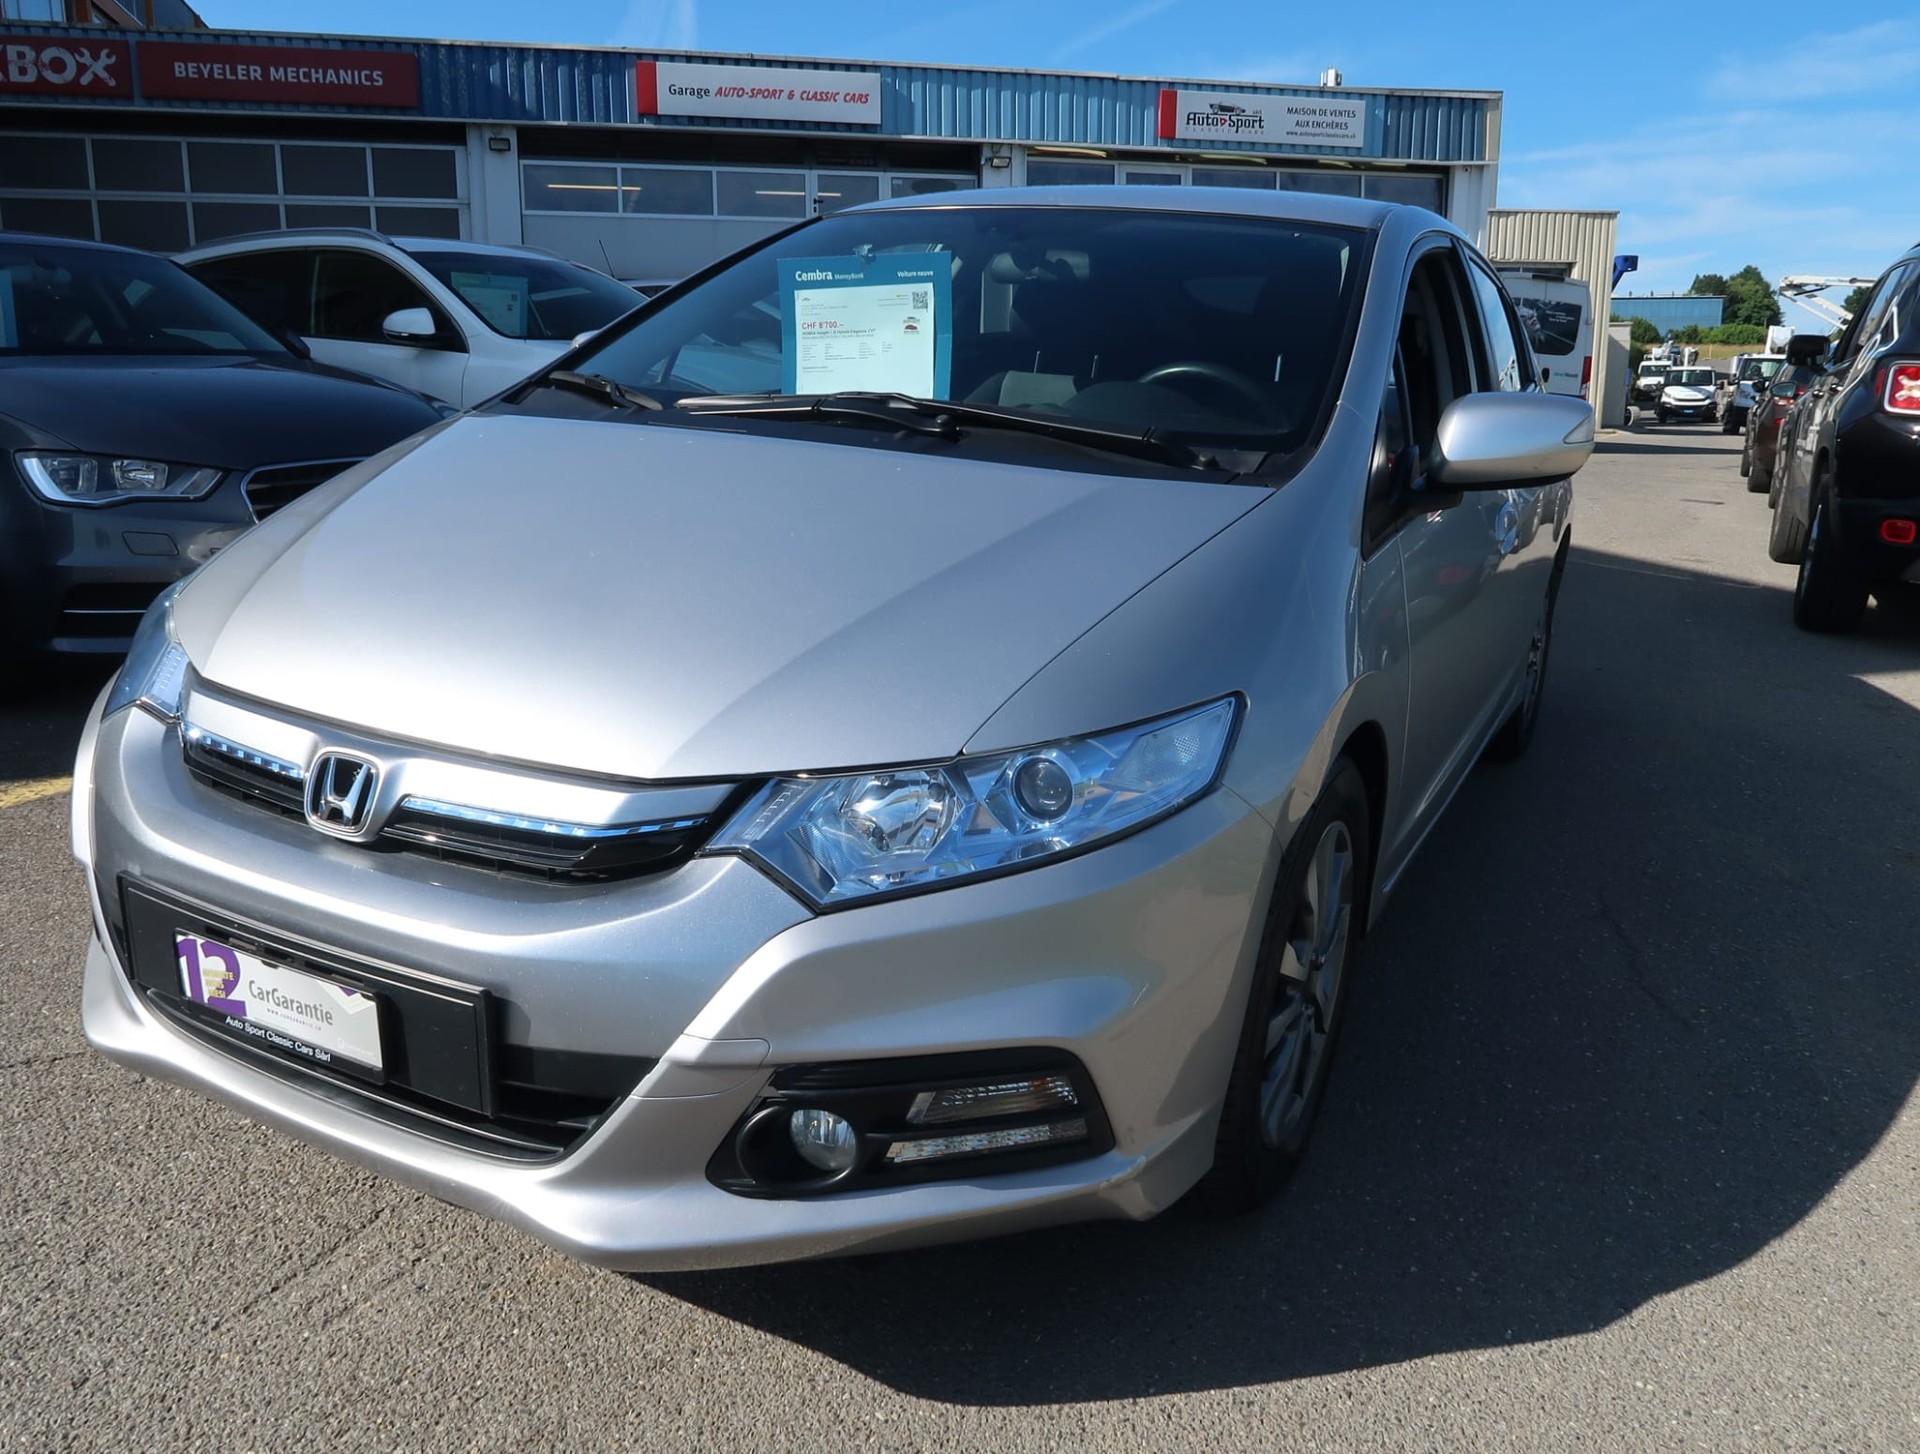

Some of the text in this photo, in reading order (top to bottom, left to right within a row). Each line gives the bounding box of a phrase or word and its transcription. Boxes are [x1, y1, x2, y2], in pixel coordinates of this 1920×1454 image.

[174, 61, 383, 86] BEYELER MECHANICS
[668, 84, 870, 104] Garage AUTO-SPORT & CLASSIC CARS
[1186, 111, 1264, 133] Auto Sport
[1286, 106, 1356, 119] MAISON DE VENTES
[1295, 119, 1349, 130] AUX ENCHÈRES
[795, 269, 833, 282] Cembra
[801, 322, 817, 330] CHF
[177, 937, 247, 1018] 12
[248, 980, 333, 1026] CarGarantie
[225, 1015, 244, 1030] Auto
[244, 1021, 266, 1038] Sport
[266, 1030, 294, 1049] Classic
[294, 1041, 314, 1057] Cars
